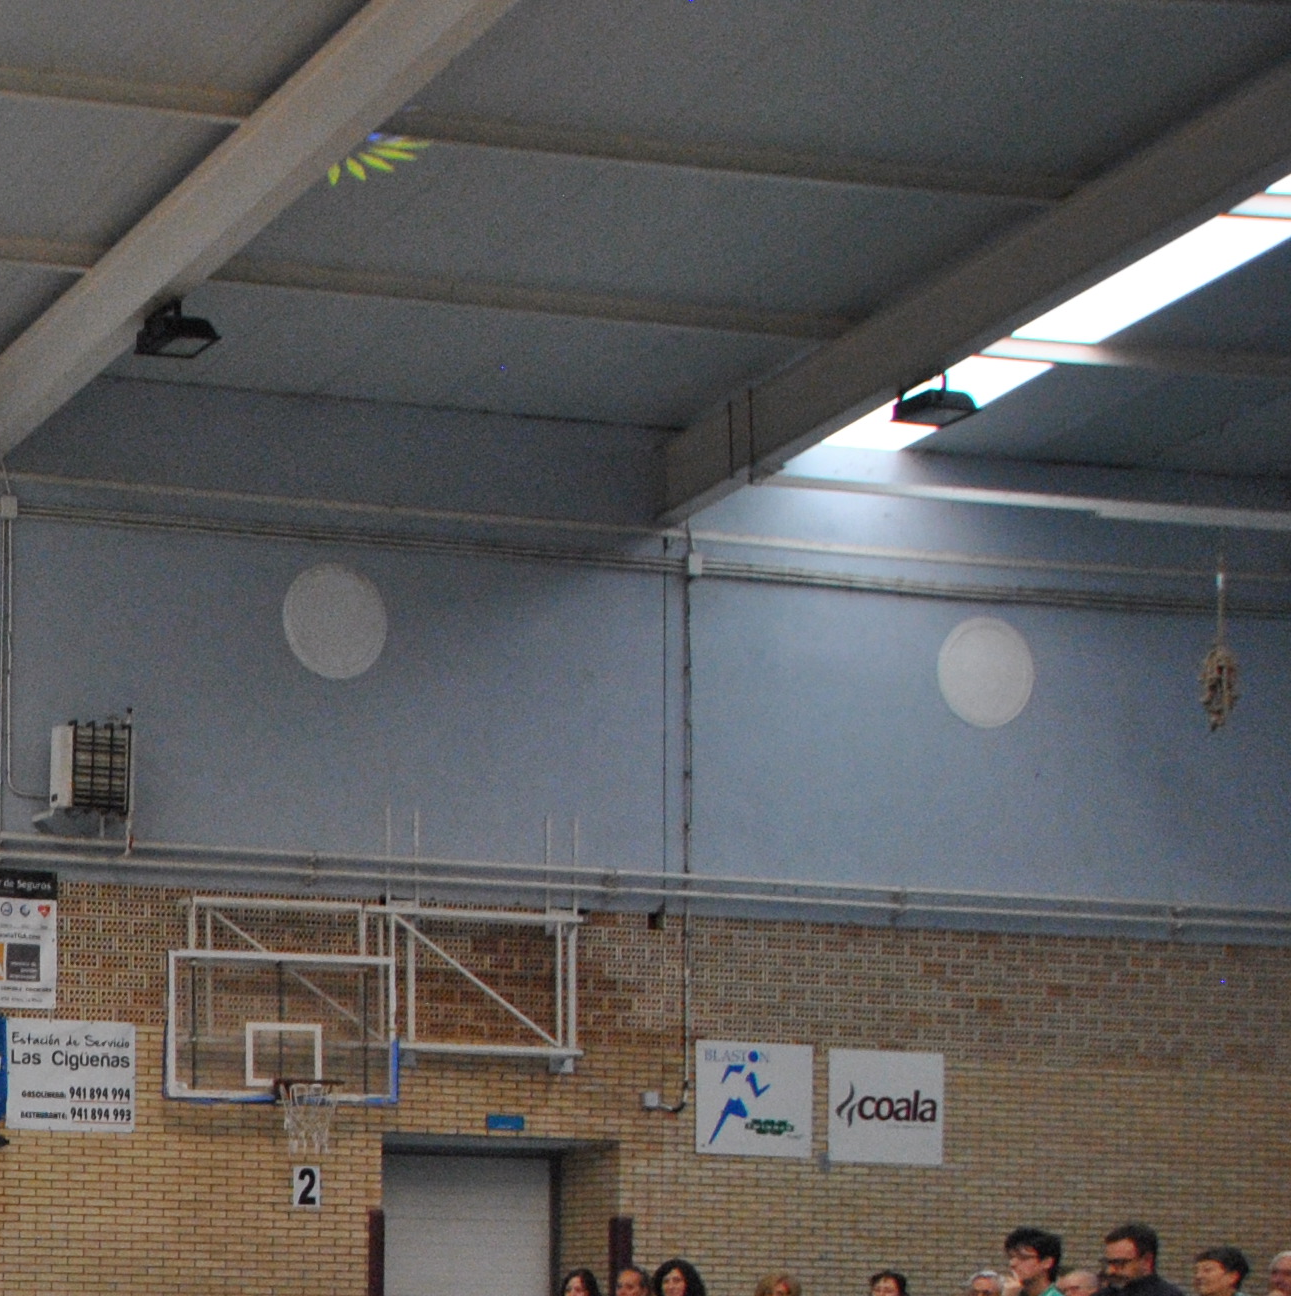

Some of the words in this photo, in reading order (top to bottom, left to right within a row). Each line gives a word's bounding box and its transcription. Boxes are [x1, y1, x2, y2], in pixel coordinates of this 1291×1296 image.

[4, 879, 15, 888] de
[17, 880, 52, 891] Seguros
[11, 1031, 60, 1046] Estación
[66, 1035, 80, 1047] de
[84, 1034, 130, 1048] Servicio
[11, 1049, 42, 1065] Las
[51, 1050, 130, 1071] Cigüeñas
[69, 1086, 87, 1099] 941
[89, 1087, 108, 1100] 894
[111, 1088, 131, 1100] 994
[70, 1107, 88, 1120] 941
[90, 1108, 109, 1121] 894
[113, 1109, 131, 1121] 993
[858, 1089, 937, 1122] coala
[297, 1167, 317, 1206] 2
